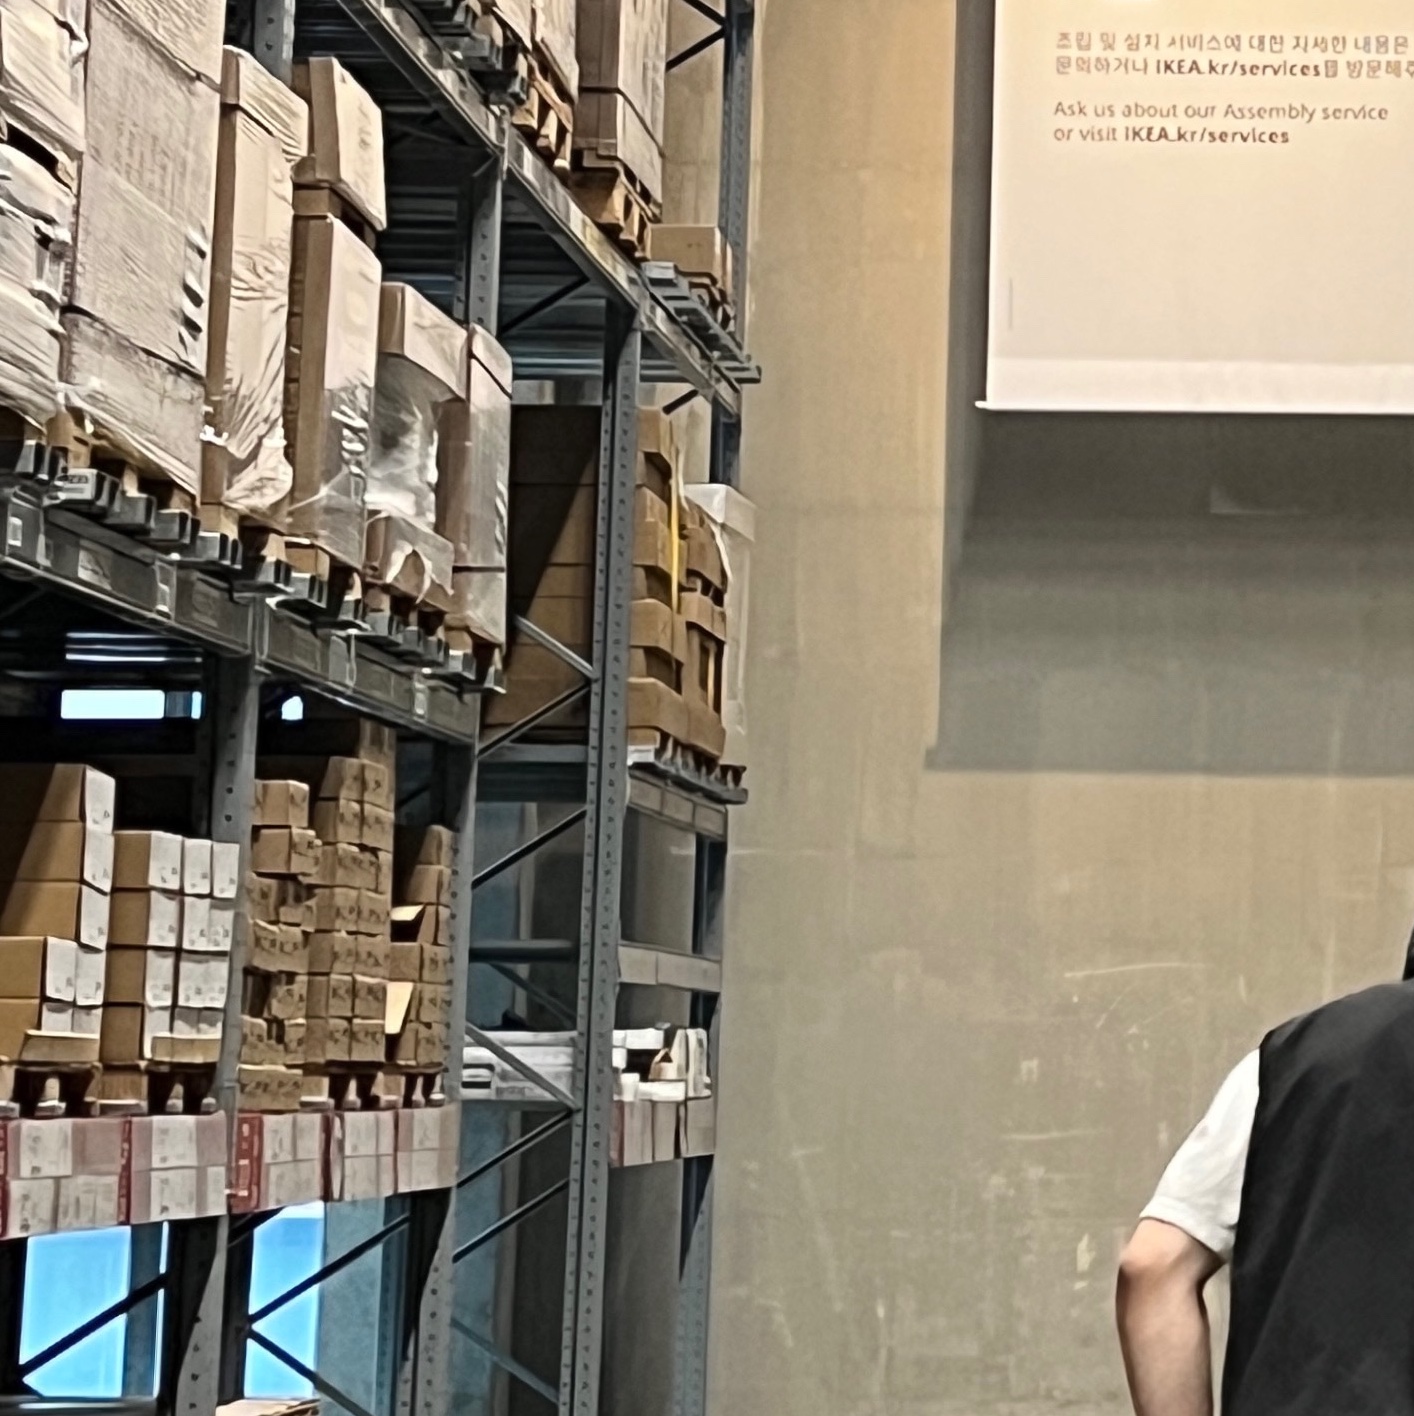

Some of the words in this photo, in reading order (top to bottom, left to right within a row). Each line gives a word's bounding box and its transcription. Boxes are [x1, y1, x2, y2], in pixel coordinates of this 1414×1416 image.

[1053, 100, 1088, 118] Ask
[1093, 103, 1116, 119] us
[1121, 101, 1179, 119] about
[1183, 104, 1217, 119] our
[1223, 102, 1317, 125] Assembly
[1321, 104, 1389, 121] service
[1053, 127, 1075, 142] or
[1078, 125, 1118, 143] visit
